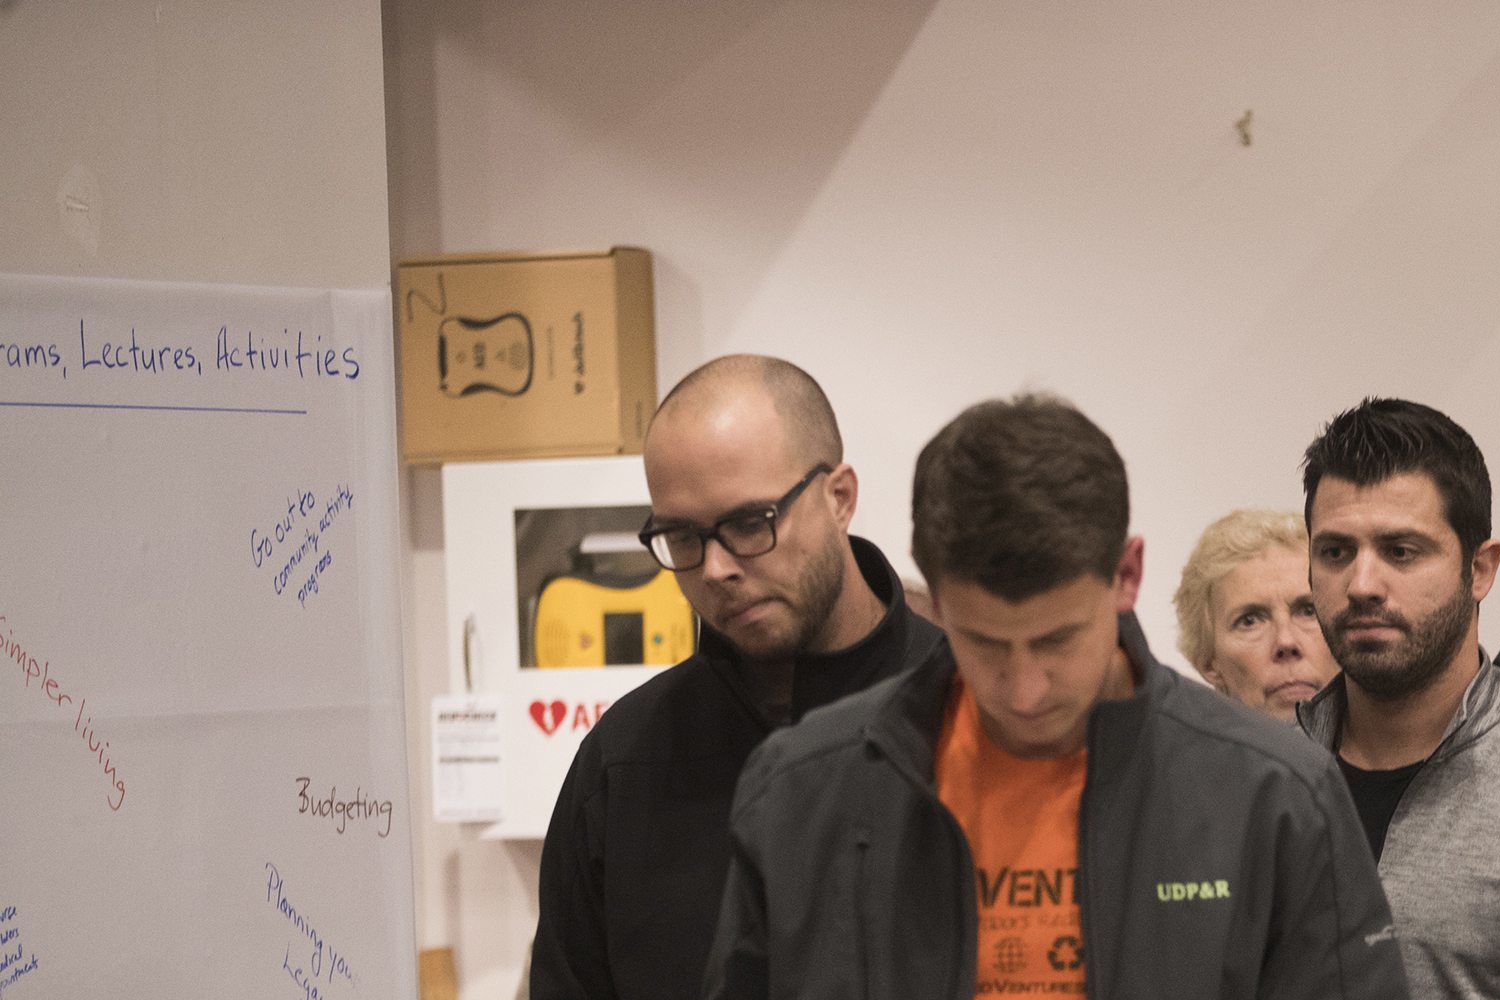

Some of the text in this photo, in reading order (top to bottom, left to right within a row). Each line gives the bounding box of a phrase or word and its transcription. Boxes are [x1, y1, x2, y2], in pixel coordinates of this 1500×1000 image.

[81, 318, 202, 377] Lectures,
[216, 325, 361, 379] Activities
[296, 776, 393, 838] Budgeting
[265, 862, 323, 977] Planning
[1157, 879, 1231, 902] UDP&R
